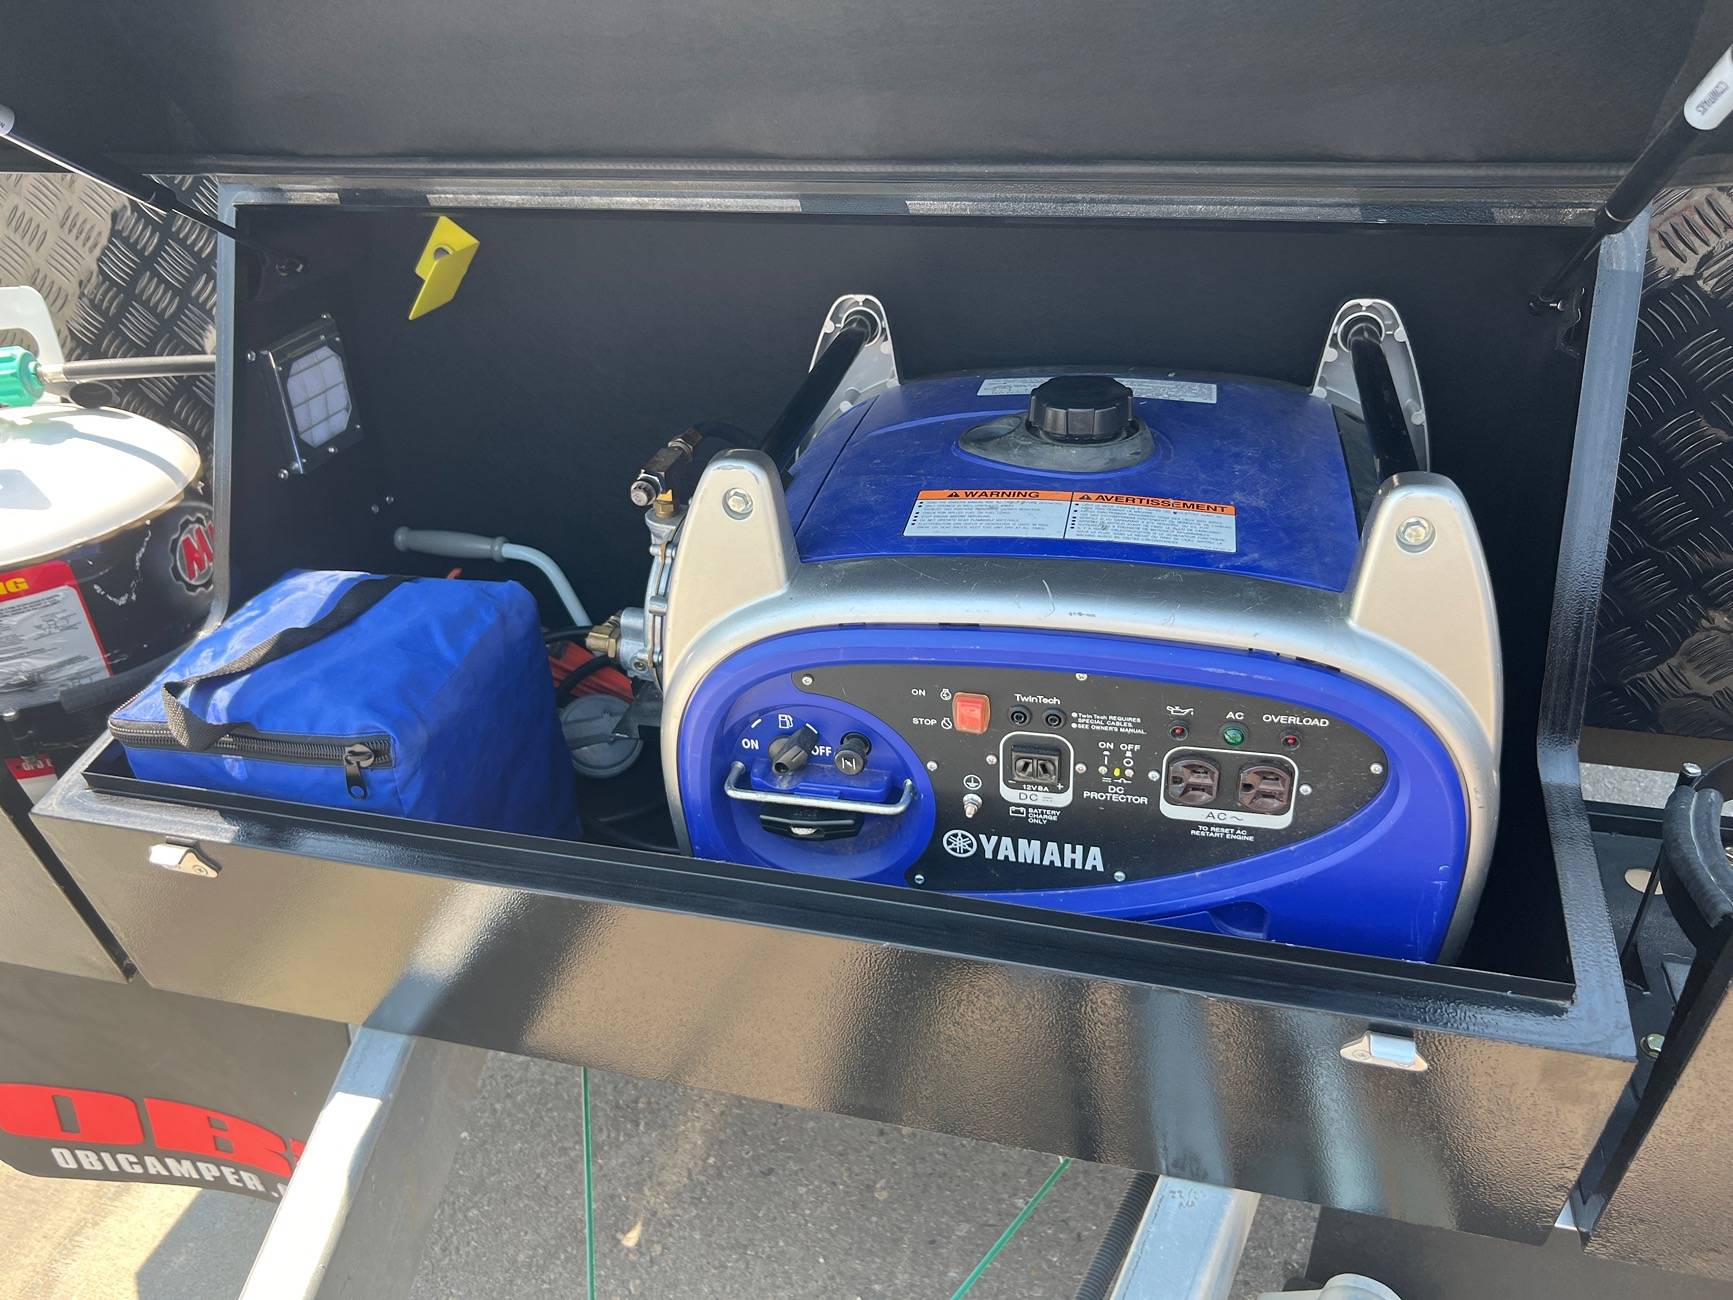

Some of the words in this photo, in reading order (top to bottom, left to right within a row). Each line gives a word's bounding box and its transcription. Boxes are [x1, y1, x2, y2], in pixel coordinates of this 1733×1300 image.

[1095, 494, 1229, 513] AVERTISSEMENT
[911, 688, 926, 697] ON
[1014, 693, 1061, 705] TwinTech
[1108, 715, 1141, 723] REQUIRES
[1225, 711, 1245, 720] AC
[1262, 714, 1330, 727] OVERLOAD
[912, 717, 937, 726] STOP
[741, 738, 759, 750] ON
[1098, 741, 1114, 750] ON
[1119, 743, 1141, 752] OFF
[1107, 785, 1125, 794] DC
[1019, 792, 1038, 801] DC
[1083, 791, 1149, 805] PROTECTOR
[1028, 807, 1061, 816] BATTERY
[1205, 811, 1228, 821] AC
[1210, 826, 1235, 834] RESET
[1190, 830, 1224, 838] RESTART
[1226, 833, 1255, 842] ENGINE
[978, 833, 1105, 872] YAMAHA
